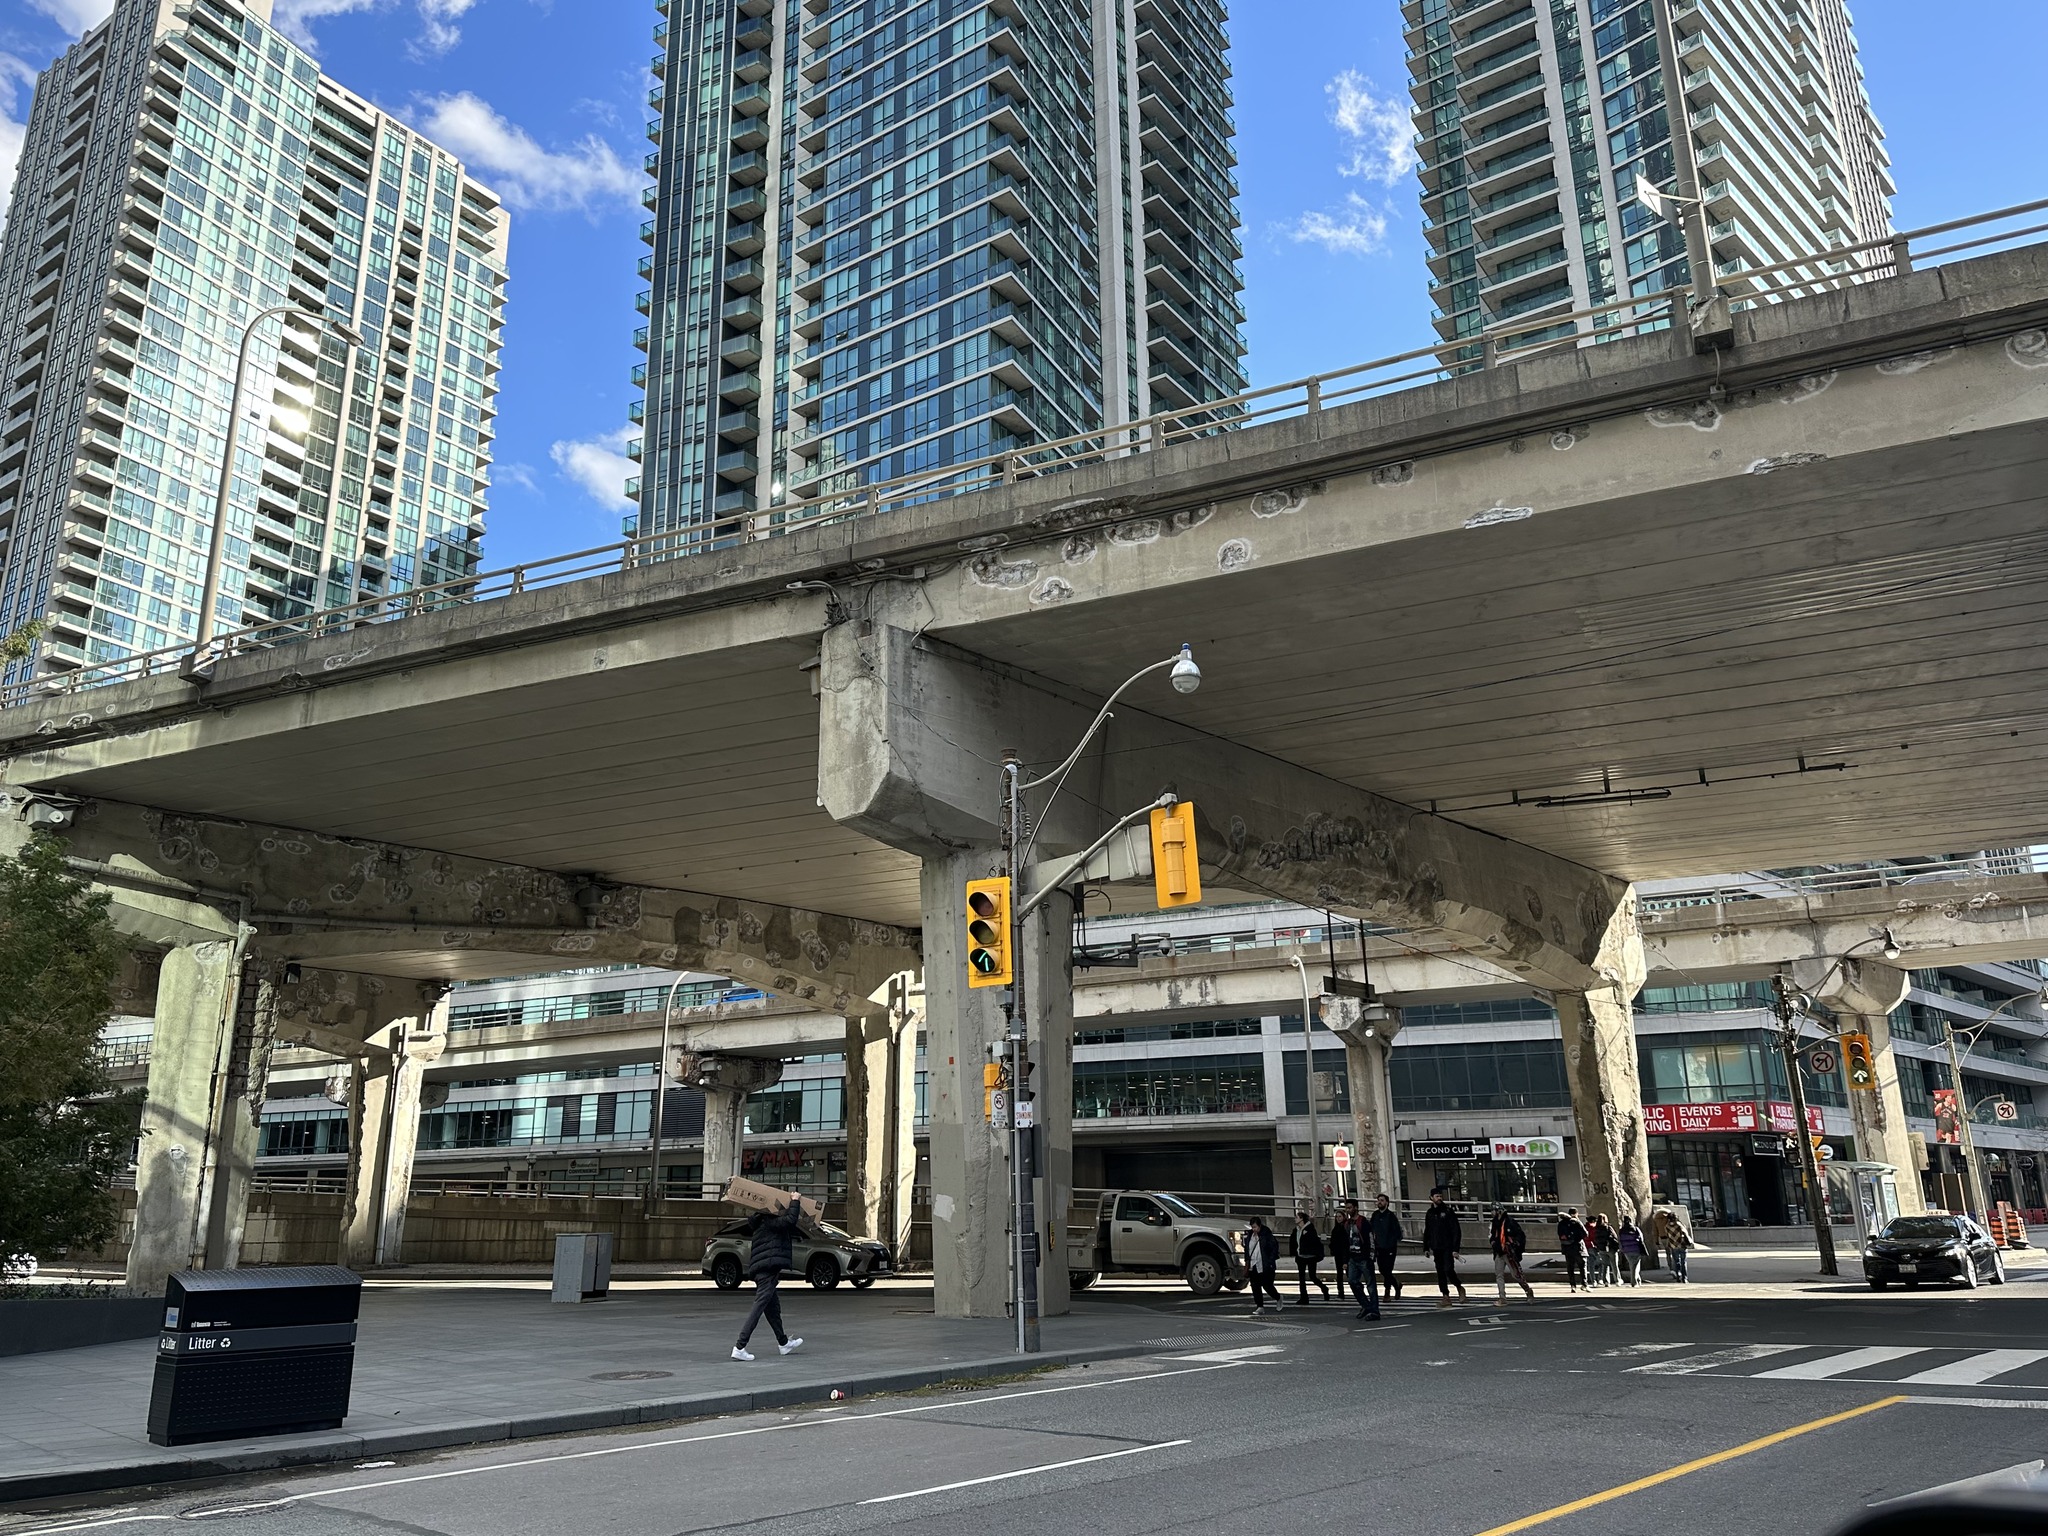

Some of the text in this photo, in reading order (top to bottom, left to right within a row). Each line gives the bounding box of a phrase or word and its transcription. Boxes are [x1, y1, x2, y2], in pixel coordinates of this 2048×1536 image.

[1641, 1107, 1665, 1119] BLIC
[1679, 1105, 1753, 1117] EVENTS $20
[1644, 1119, 1672, 1131] KING
[1681, 1118, 1711, 1128] DAILY
[1415, 1145, 1451, 1155] SECOND
[1451, 1146, 1469, 1154] CUP
[1495, 1142, 1552, 1154] Pita Pit
[742, 1147, 805, 1169] E/MAX
[188, 1336, 217, 1350] Litter
